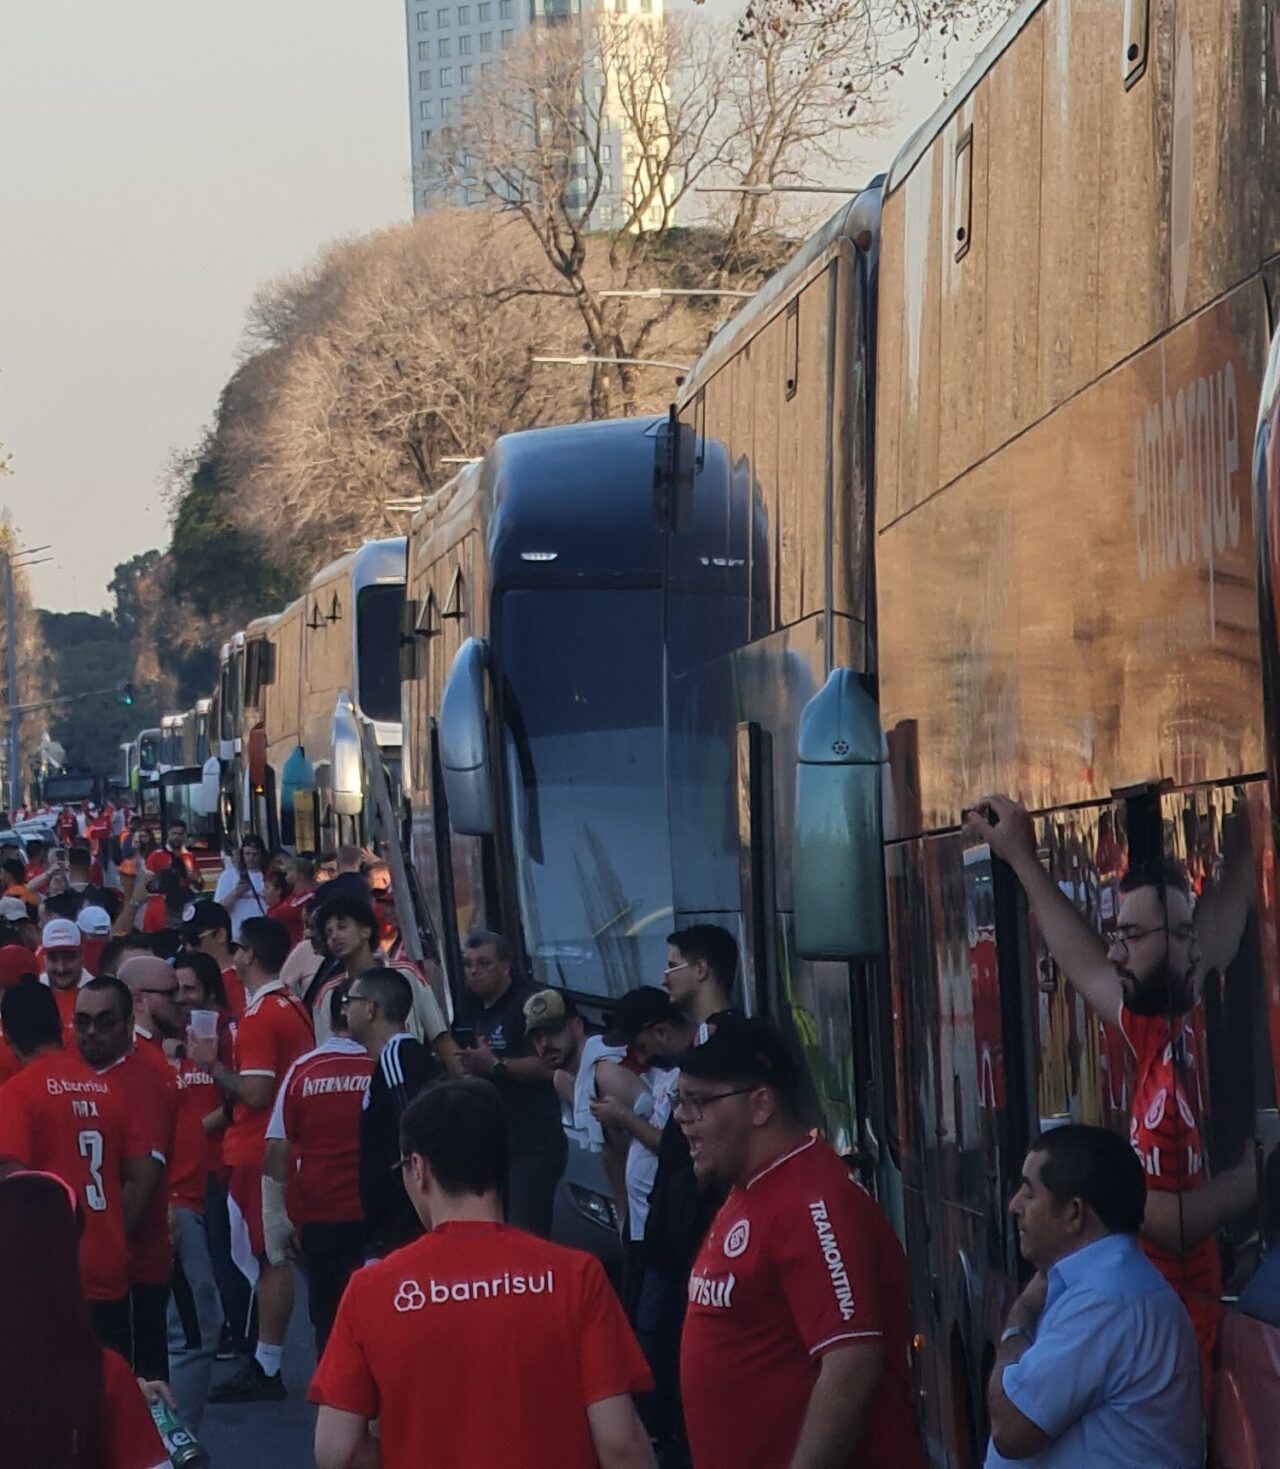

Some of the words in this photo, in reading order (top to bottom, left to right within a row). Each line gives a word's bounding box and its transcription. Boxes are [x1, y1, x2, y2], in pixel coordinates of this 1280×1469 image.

[78, 1130, 107, 1211] 3
[430, 1270, 553, 1304] banrisul
[809, 1199, 855, 1321] TRAMONTINA
